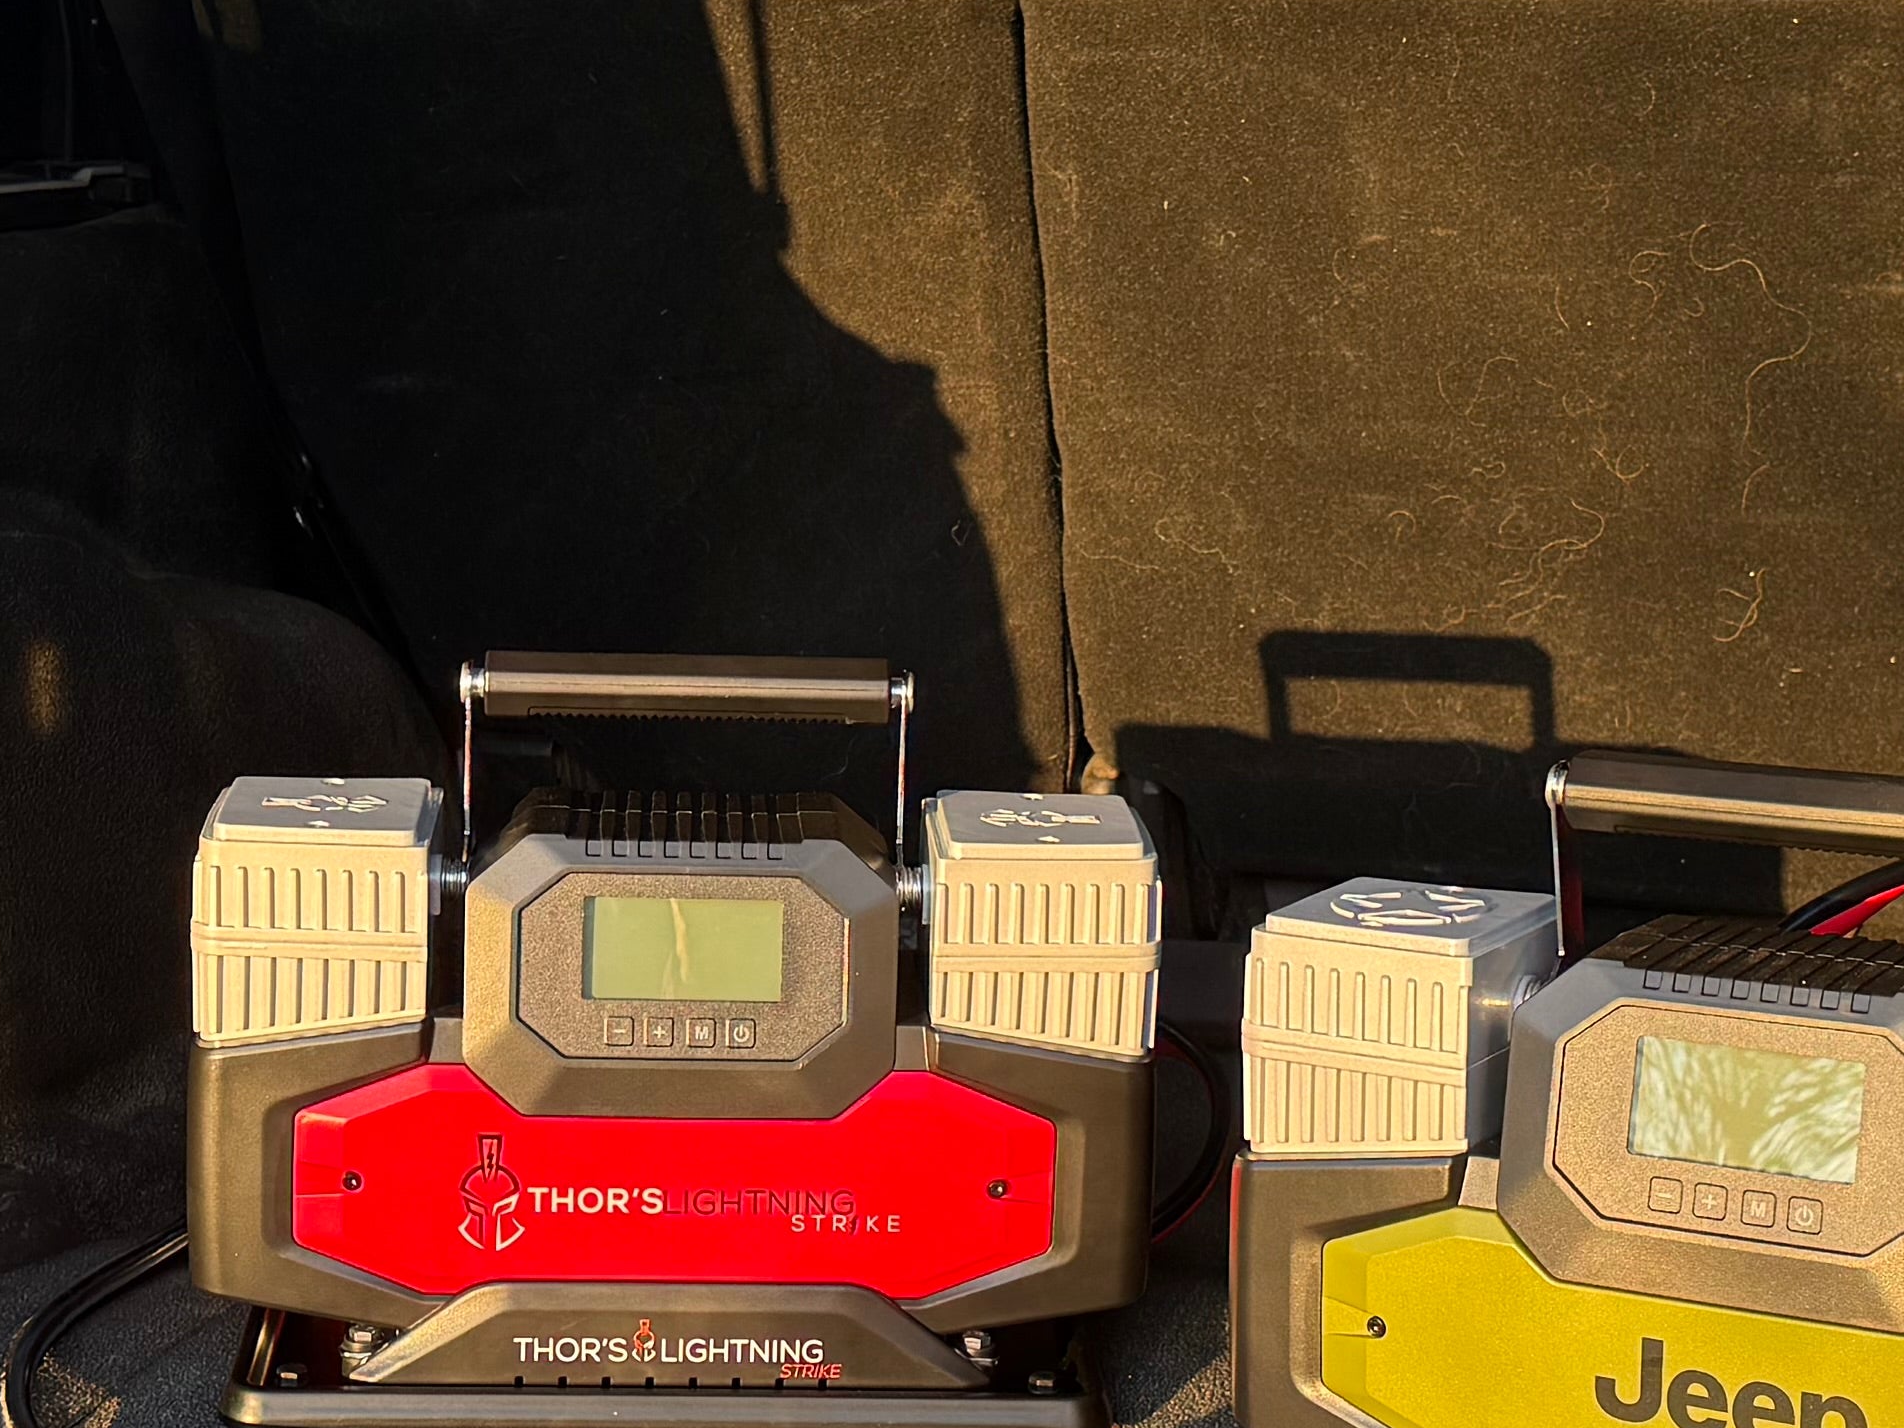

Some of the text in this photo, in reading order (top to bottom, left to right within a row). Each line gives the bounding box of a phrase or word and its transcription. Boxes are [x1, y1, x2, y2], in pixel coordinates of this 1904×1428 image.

[695, 1026, 709, 1040] M
[527, 1186, 856, 1217] THOR'S LIGHTNING
[1751, 1201, 1766, 1218] M
[513, 1337, 824, 1364] THOR'S LIGHTNING
[779, 1363, 842, 1380] STRIKE
